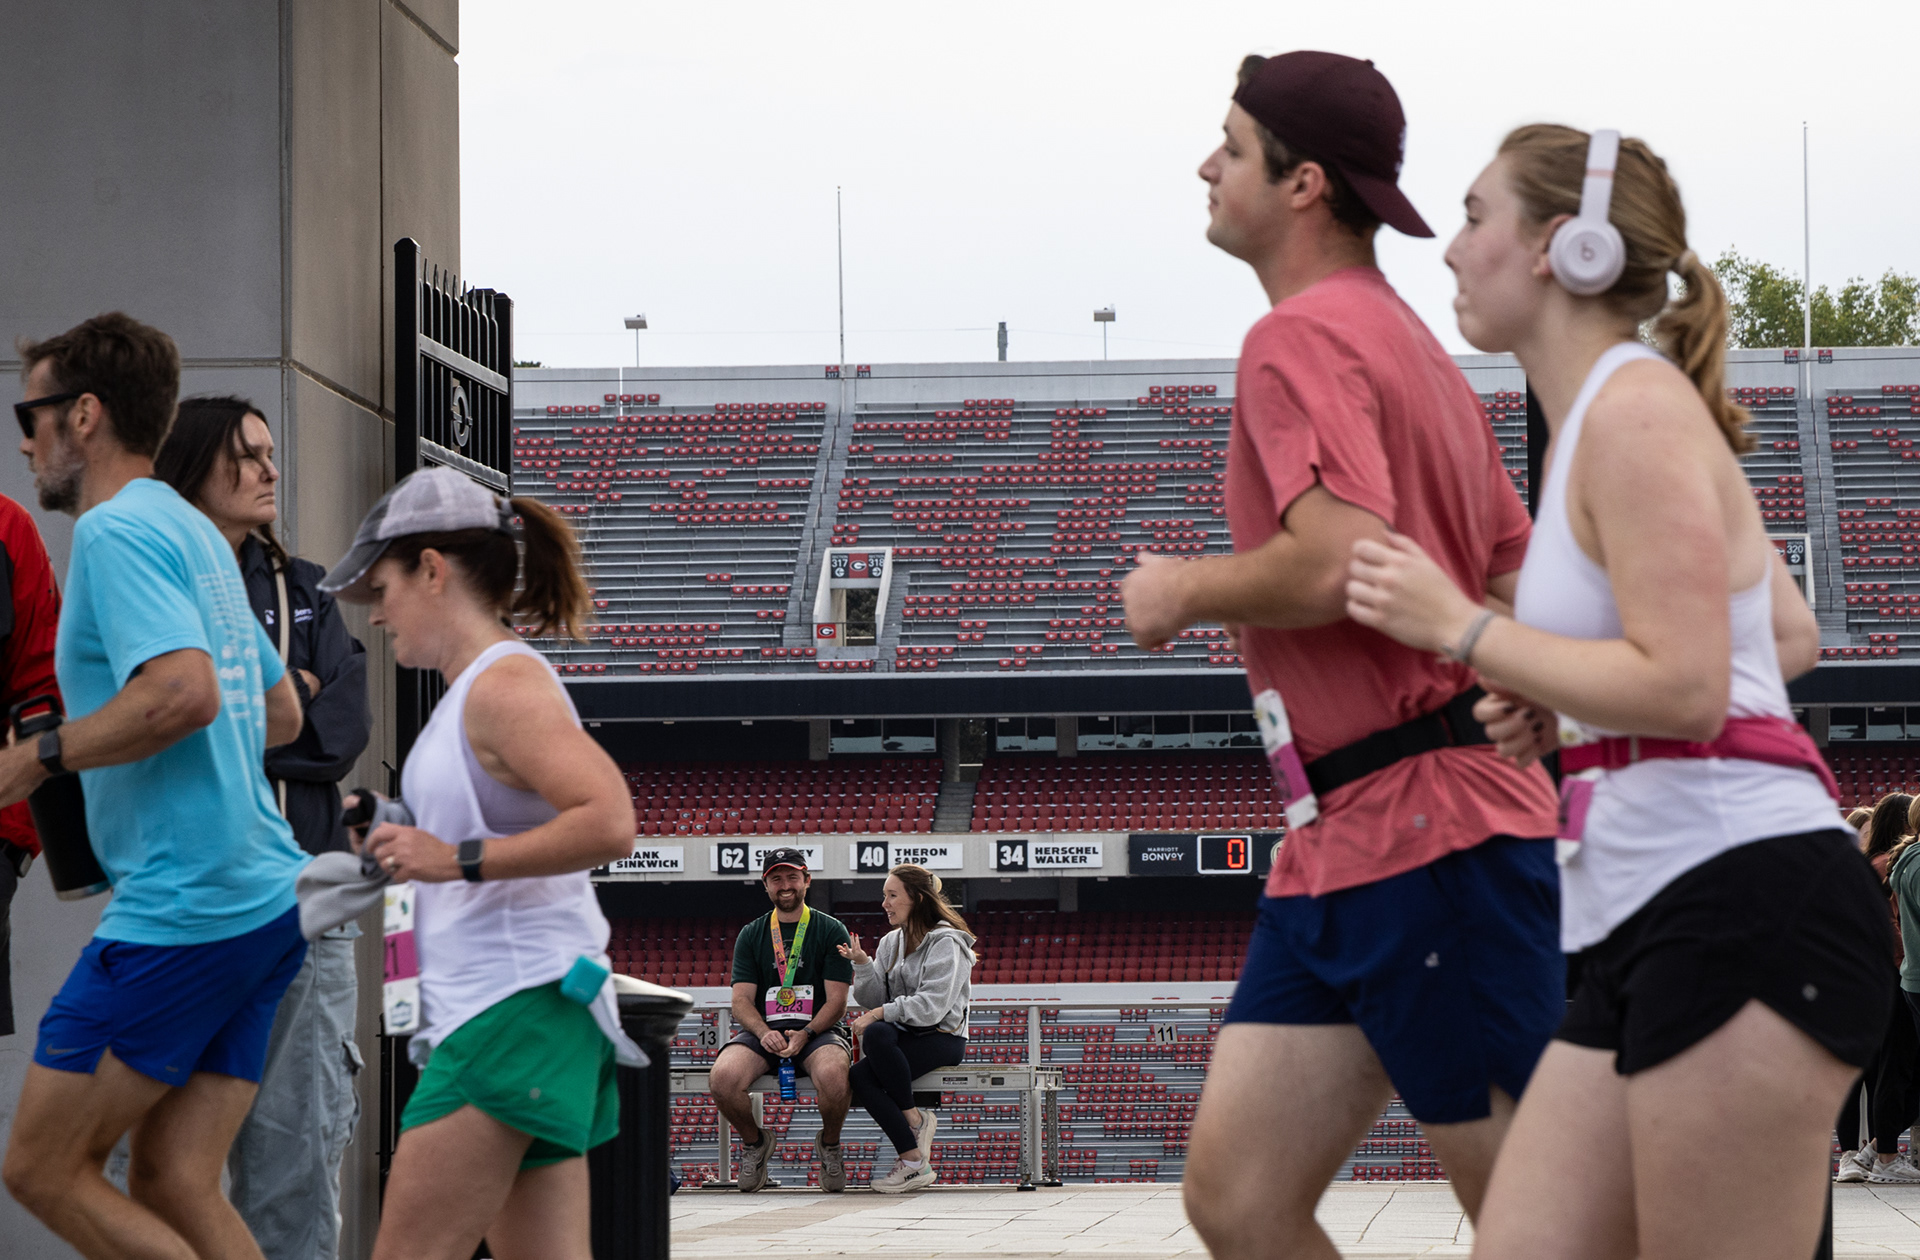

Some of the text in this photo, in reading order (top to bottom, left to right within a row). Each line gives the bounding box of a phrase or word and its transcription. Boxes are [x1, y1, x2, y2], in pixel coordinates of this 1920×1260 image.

[1786, 544, 1804, 554] 320
[831, 558, 849, 568] 317
[895, 848, 948, 857] THERON
[1000, 845, 1024, 866] 34
[1035, 847, 1099, 855] HERSCHEL
[1227, 839, 1245, 869] 0
[721, 848, 745, 868] 62
[860, 846, 885, 867] 40
[895, 857, 928, 865] SAPP
[1035, 855, 1088, 864] WALKER
[616, 860, 679, 868] SINKWICH
[699, 1030, 716, 1045] 13
[1157, 1026, 1173, 1041] 11
